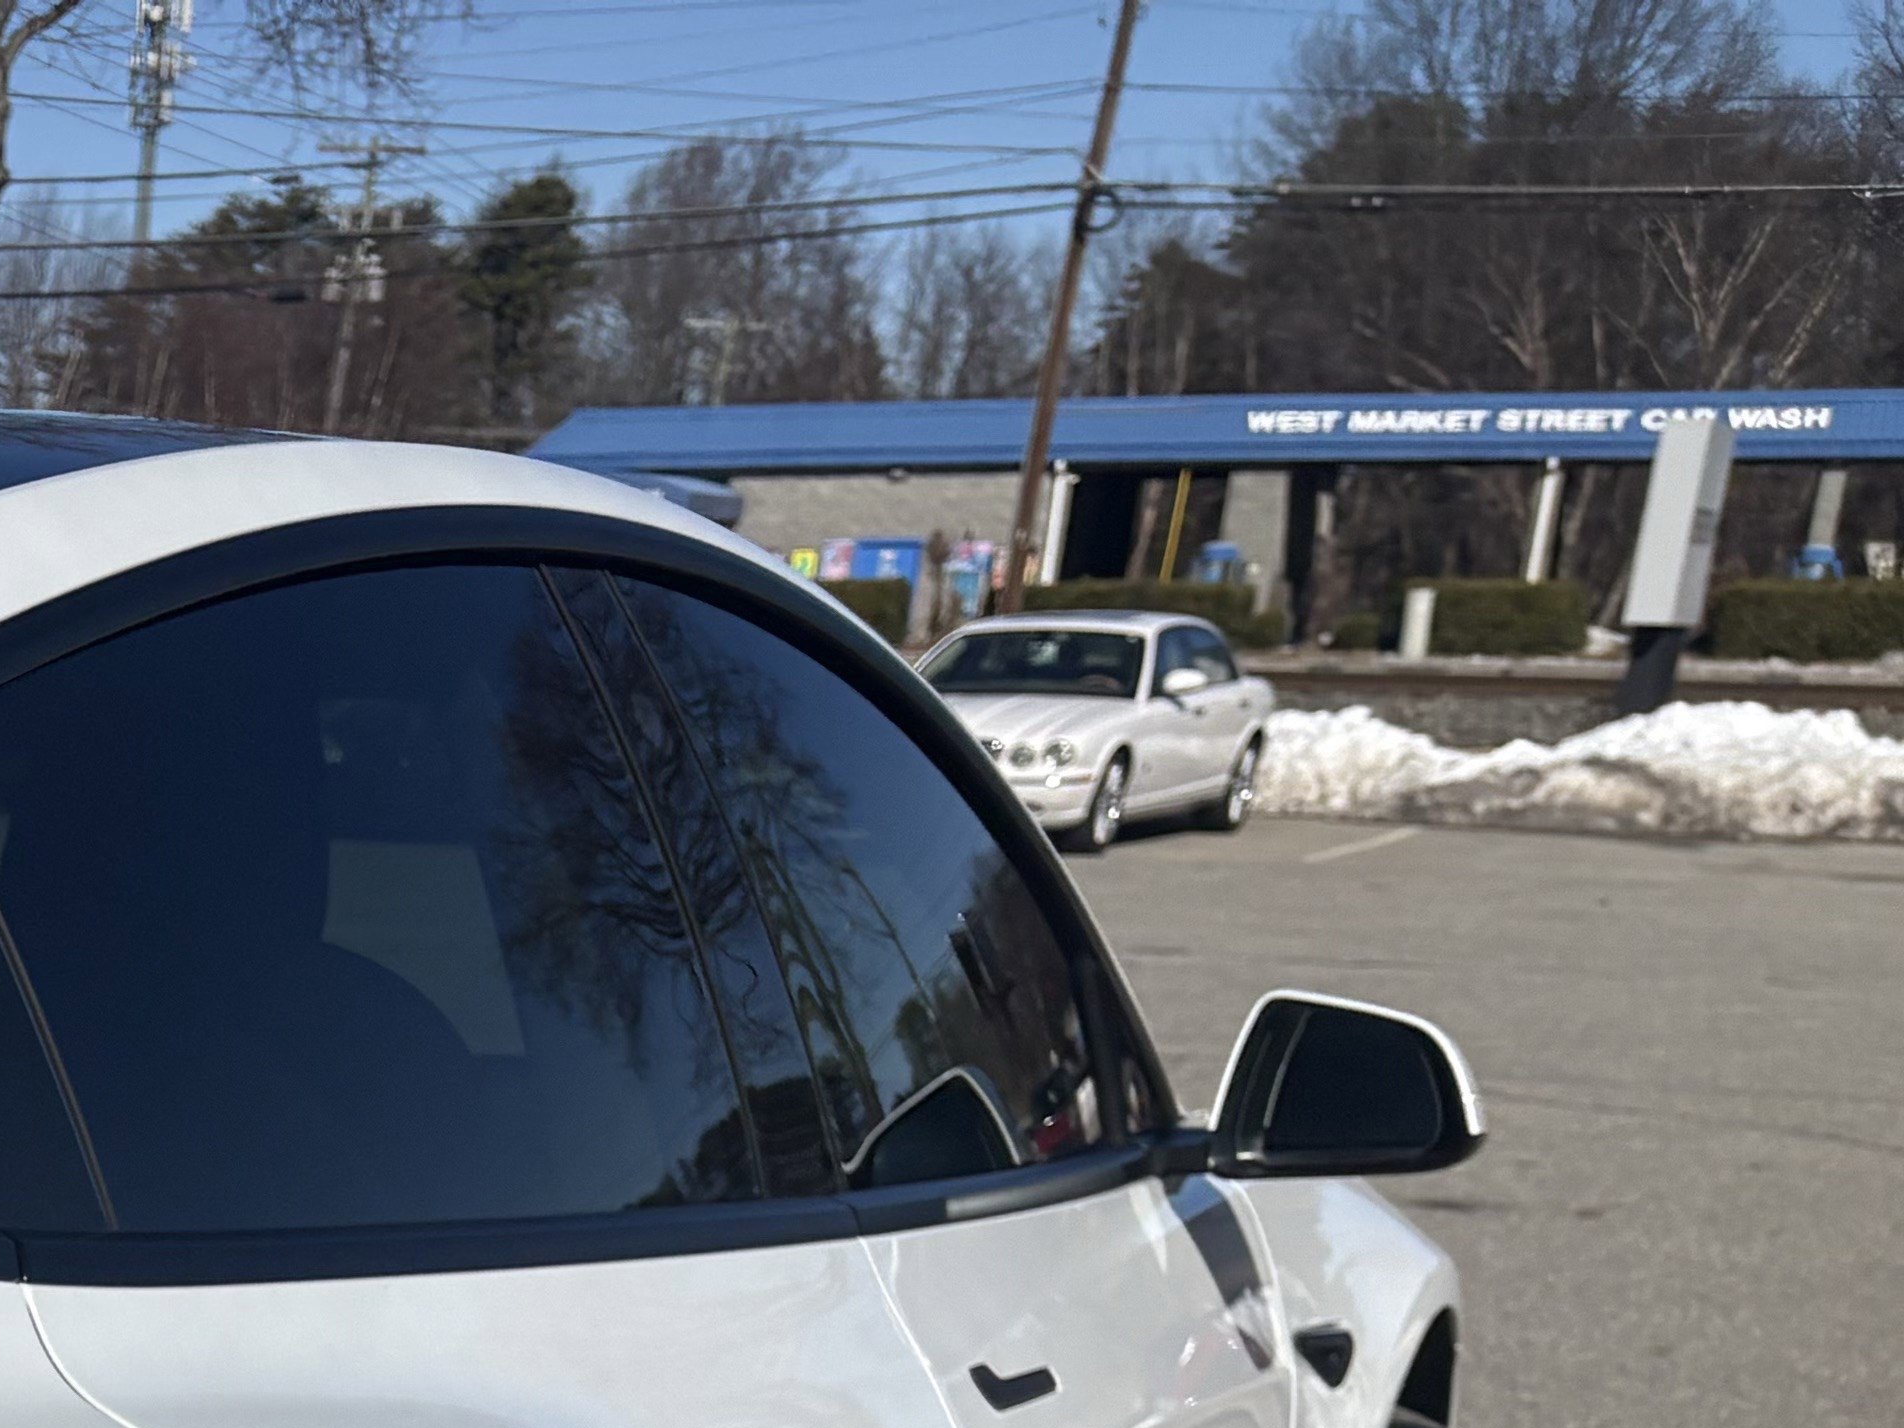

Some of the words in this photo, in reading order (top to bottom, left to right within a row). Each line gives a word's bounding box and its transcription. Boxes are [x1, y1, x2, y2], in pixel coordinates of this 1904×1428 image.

[1247, 409, 1343, 434] WEST
[1346, 409, 1492, 434] MARKET
[1495, 407, 1633, 433] STREET
[1726, 406, 1834, 430] WASH
